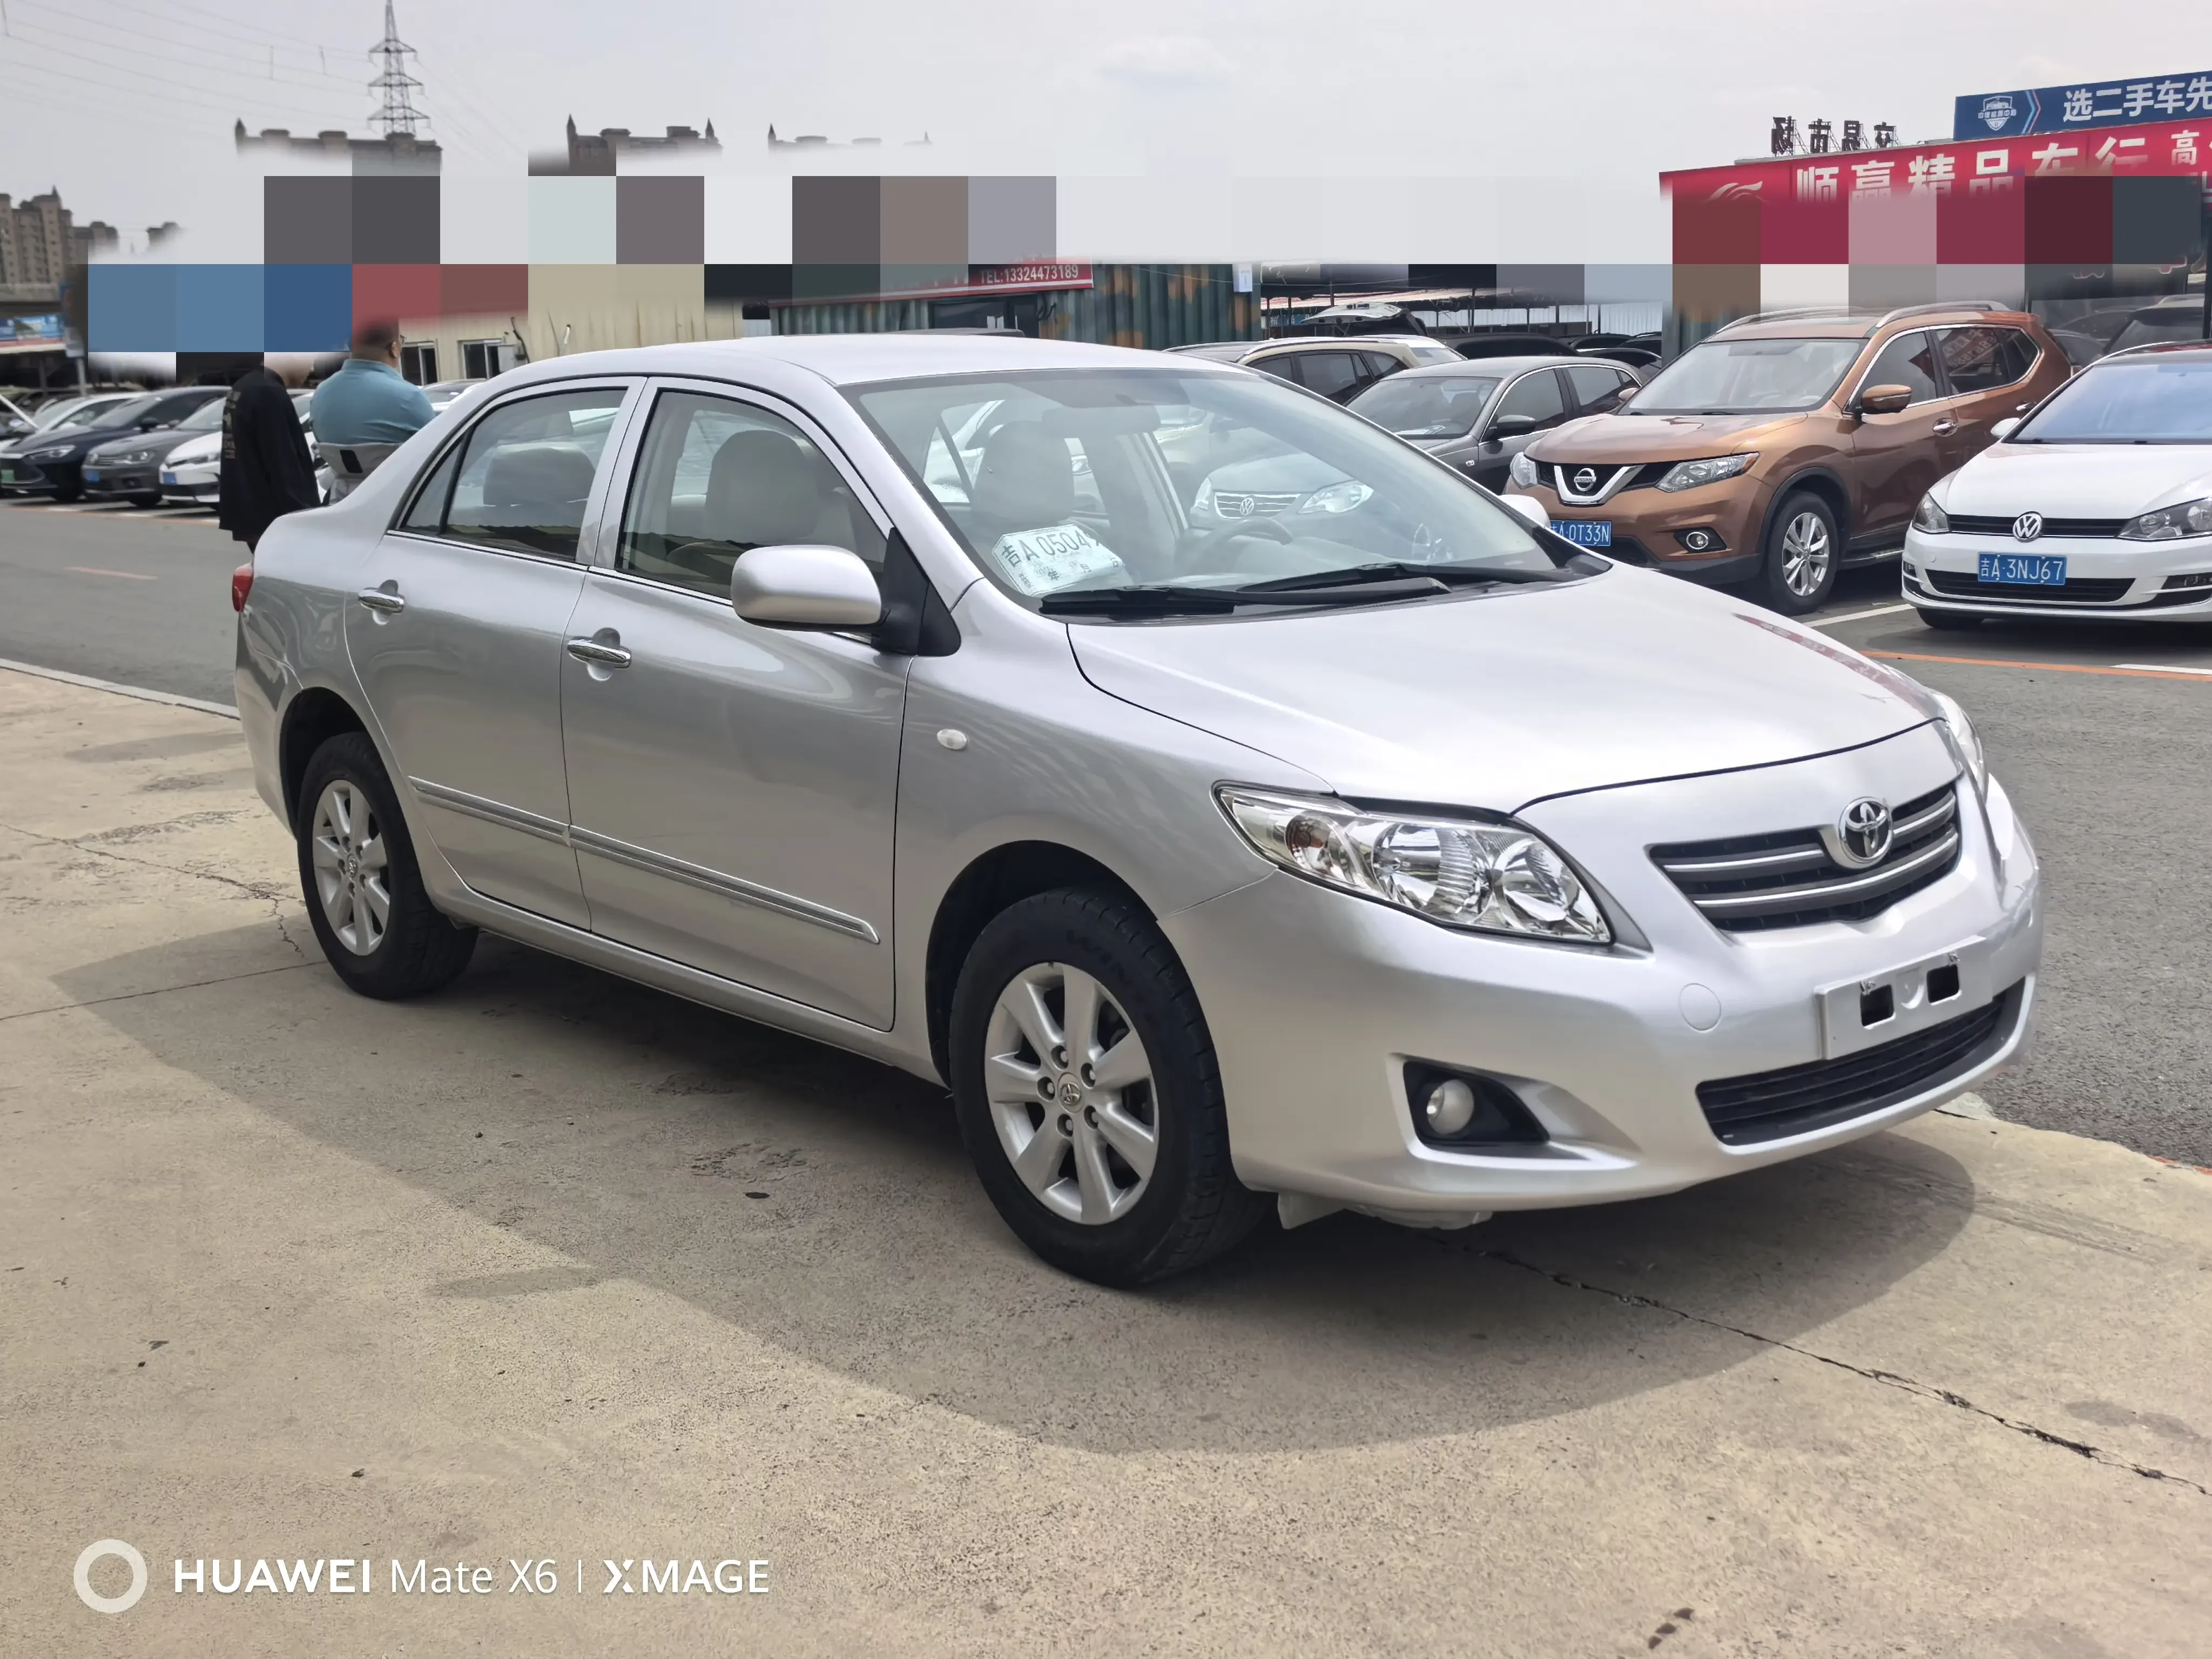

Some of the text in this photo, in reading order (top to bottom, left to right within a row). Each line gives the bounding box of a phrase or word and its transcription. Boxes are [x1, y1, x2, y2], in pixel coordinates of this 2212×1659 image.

[2063, 76, 2212, 122] 选二手车先
[980, 264, 1078, 285] TEL:13324473189
